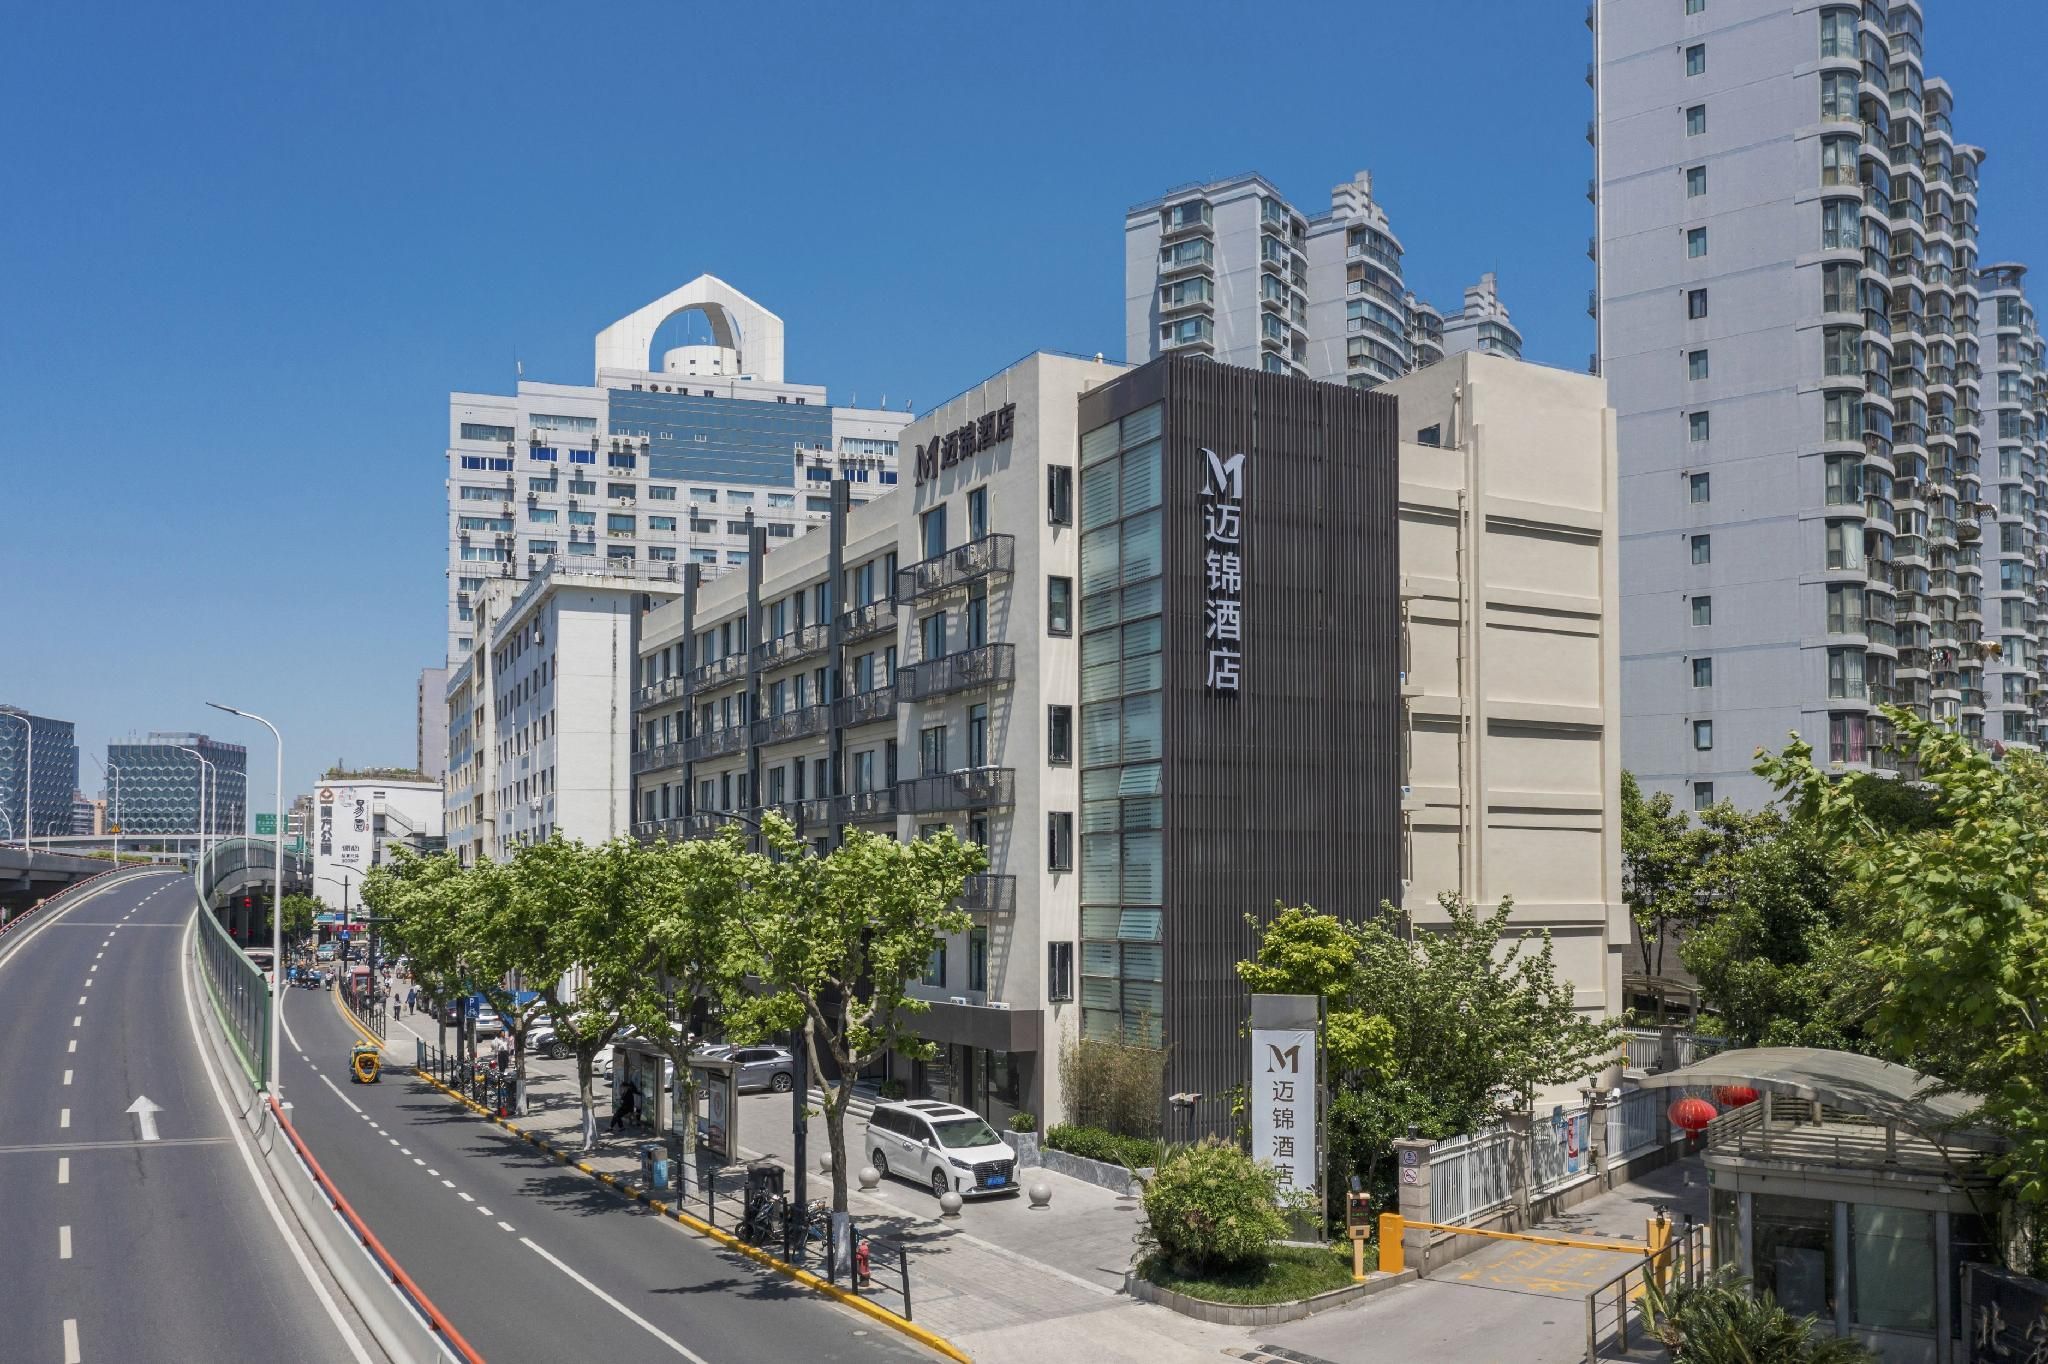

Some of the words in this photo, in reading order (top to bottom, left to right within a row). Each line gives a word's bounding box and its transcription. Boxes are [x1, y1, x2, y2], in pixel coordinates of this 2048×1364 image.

[940, 402, 1016, 471] 迈锦酒店
[1199, 447, 1246, 499] M
[1206, 503, 1241, 691] 迈锦酒店
[1266, 1043, 1301, 1074] M
[1272, 1080, 1295, 1186] 迈锦酒店
